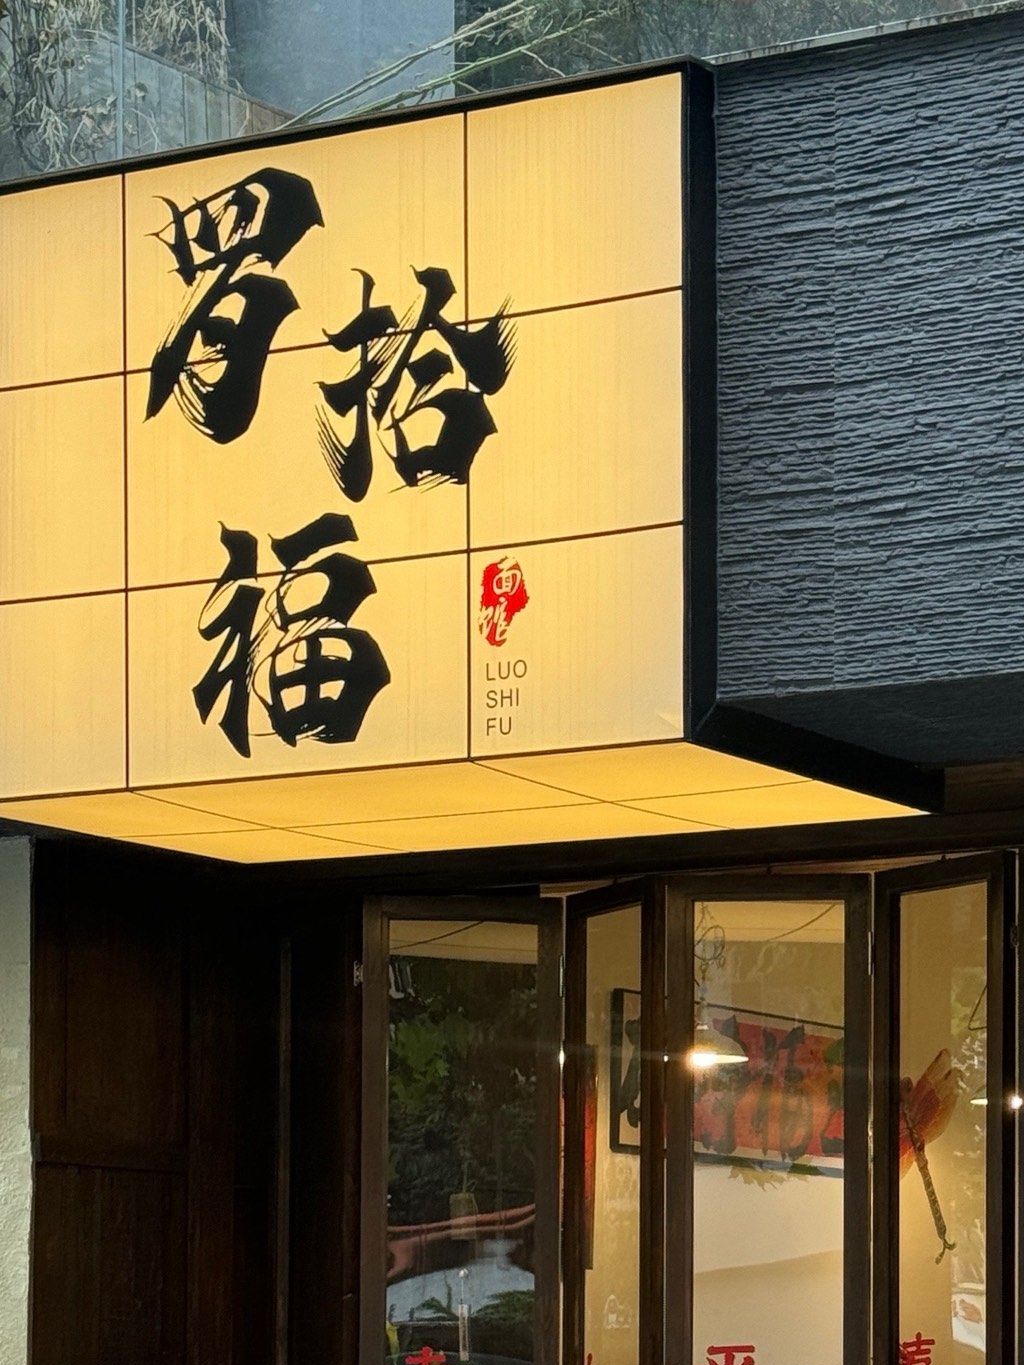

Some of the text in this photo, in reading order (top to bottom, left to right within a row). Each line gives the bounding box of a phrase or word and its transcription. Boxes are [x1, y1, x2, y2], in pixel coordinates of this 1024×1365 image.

[486, 659, 528, 682] LUO
[486, 688, 520, 709] SHI
[486, 716, 512, 737] FU
